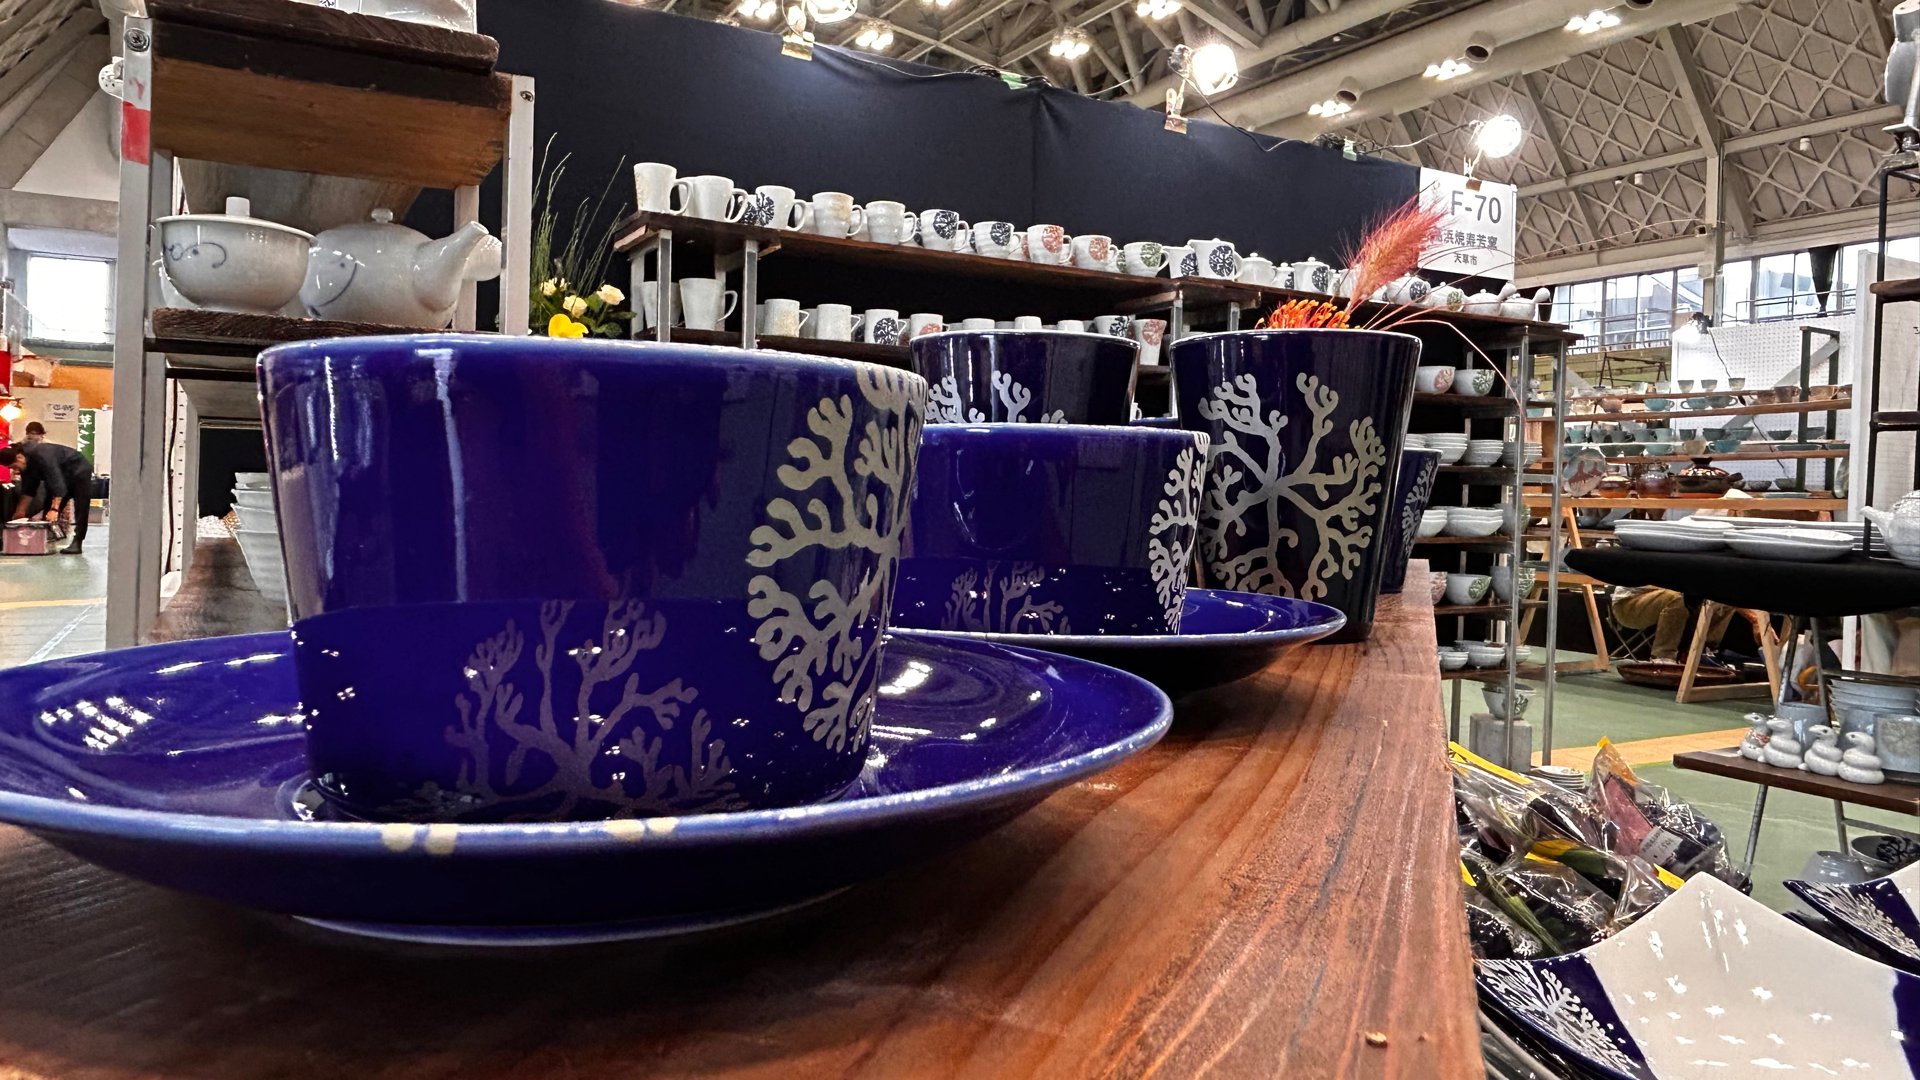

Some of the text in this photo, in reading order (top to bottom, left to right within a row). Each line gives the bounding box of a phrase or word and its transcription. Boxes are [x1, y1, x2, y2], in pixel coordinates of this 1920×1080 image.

[1450, 190, 1502, 224] F-70
[1454, 253, 1478, 266] 天草市
